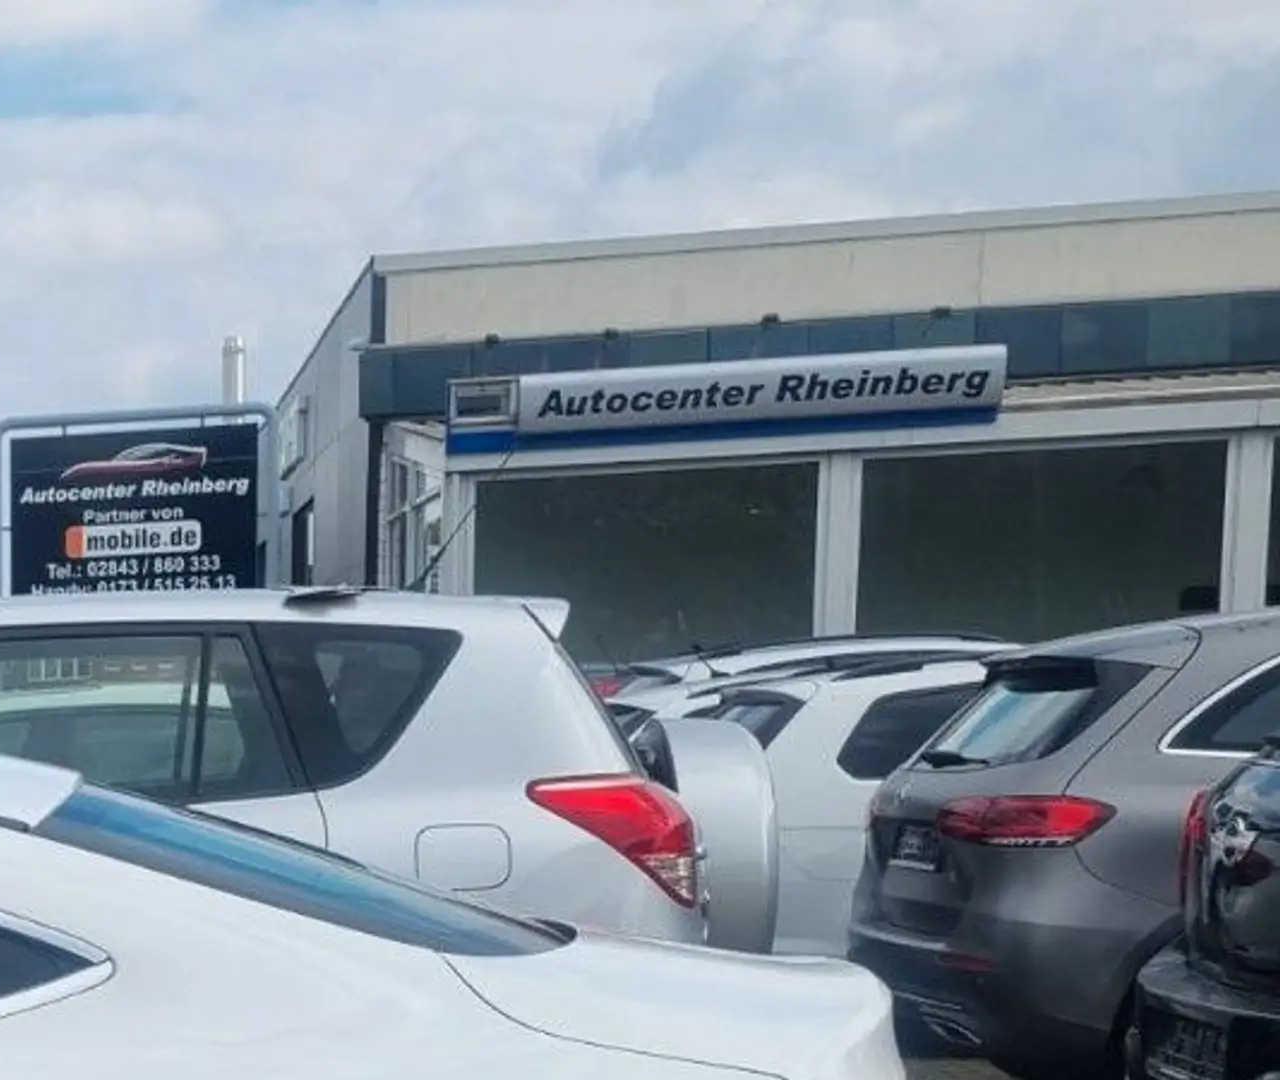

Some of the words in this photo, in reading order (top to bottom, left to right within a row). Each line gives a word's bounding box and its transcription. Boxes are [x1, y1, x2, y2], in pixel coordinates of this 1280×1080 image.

[538, 382, 765, 419] Autocenter
[776, 368, 991, 403] Rheinberg
[20, 484, 136, 504] Autocenter
[142, 476, 251, 497] Rheinberg
[82, 509, 146, 524] Partner
[151, 506, 184, 520] von
[86, 527, 198, 551] mobile.de
[46, 563, 83, 580] Tel.:
[86, 558, 140, 577] 02843
[189, 554, 222, 571] 333
[216, 573, 238, 590] 13
